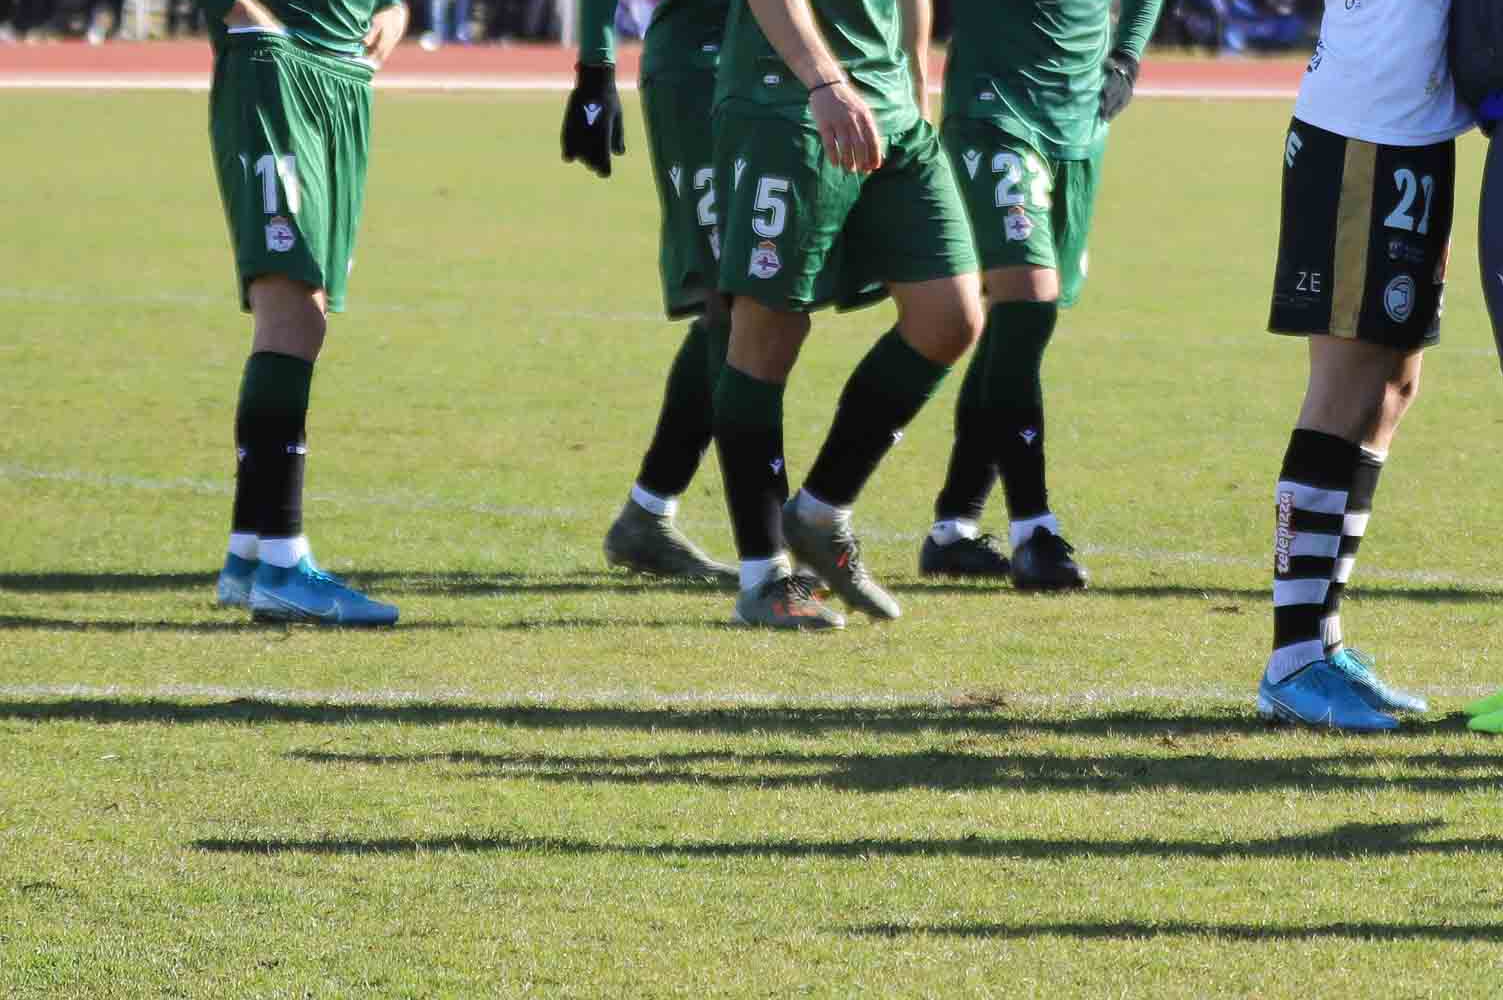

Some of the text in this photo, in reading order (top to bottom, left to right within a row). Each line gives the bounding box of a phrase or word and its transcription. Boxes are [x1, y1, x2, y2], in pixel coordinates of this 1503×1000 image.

[255, 154, 298, 215] 11
[751, 176, 788, 238] 5
[1383, 168, 1434, 235] 21
[1295, 271, 1321, 293] ZE
